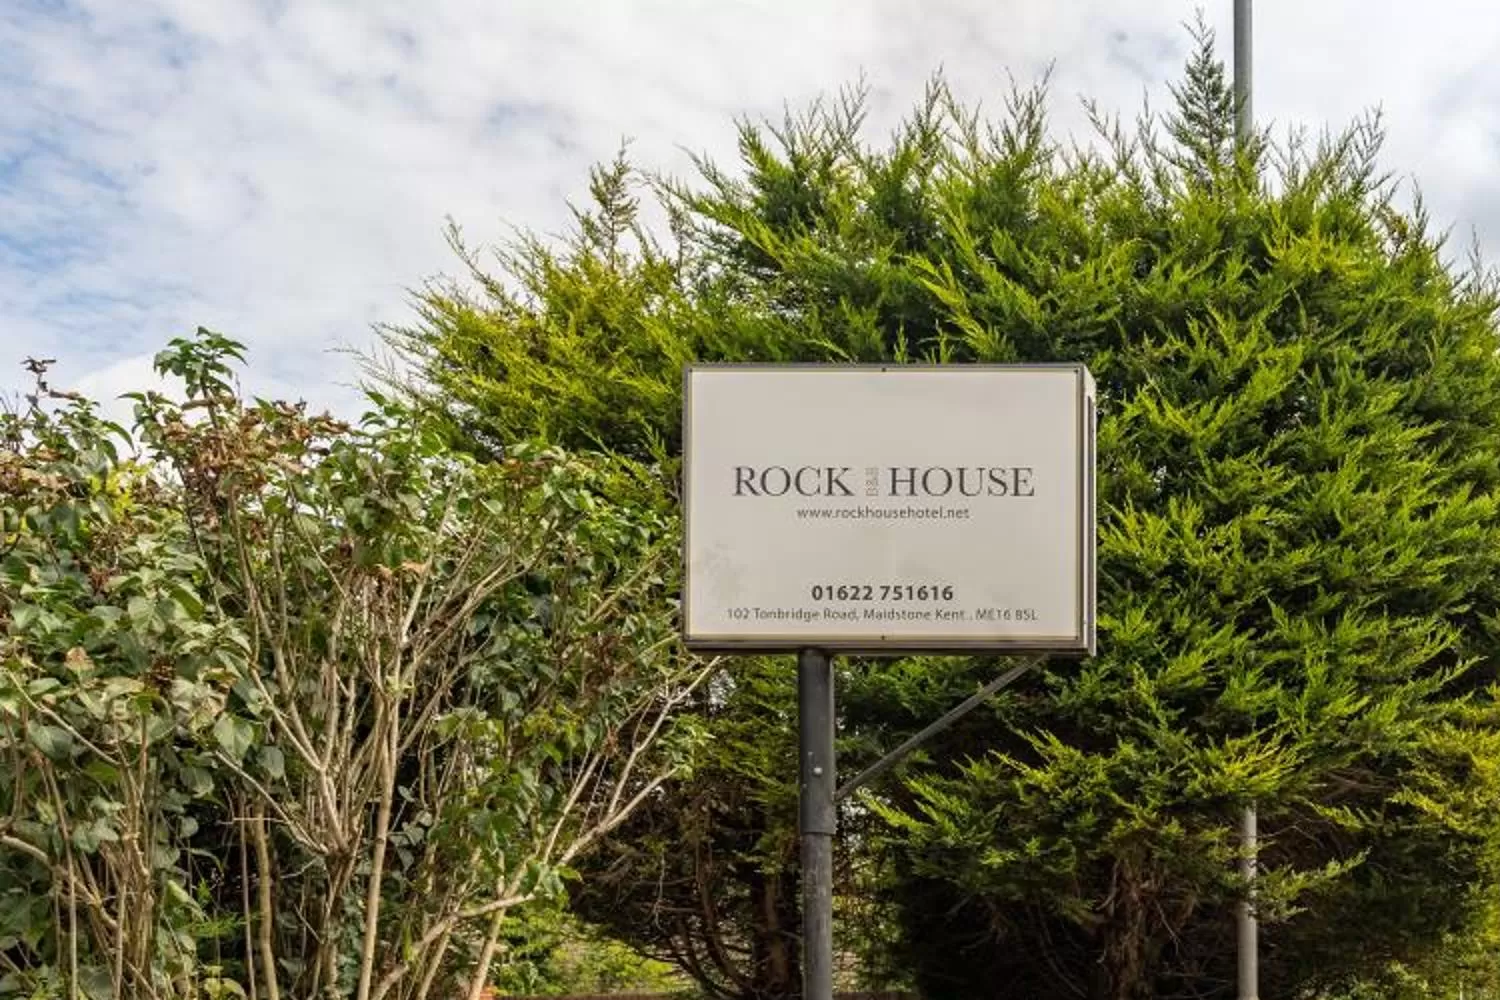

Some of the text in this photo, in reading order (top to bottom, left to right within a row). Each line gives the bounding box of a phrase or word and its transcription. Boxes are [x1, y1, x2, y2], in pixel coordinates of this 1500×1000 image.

[733, 466, 1035, 497] ROCK HOUSE
[797, 505, 970, 520] www.rockhousehotel.net
[812, 585, 954, 601] 01622 751616
[727, 608, 750, 620] 102
[753, 608, 821, 622] Tonbridge
[823, 608, 860, 621] Road,
[863, 608, 931, 620] Maidstone
